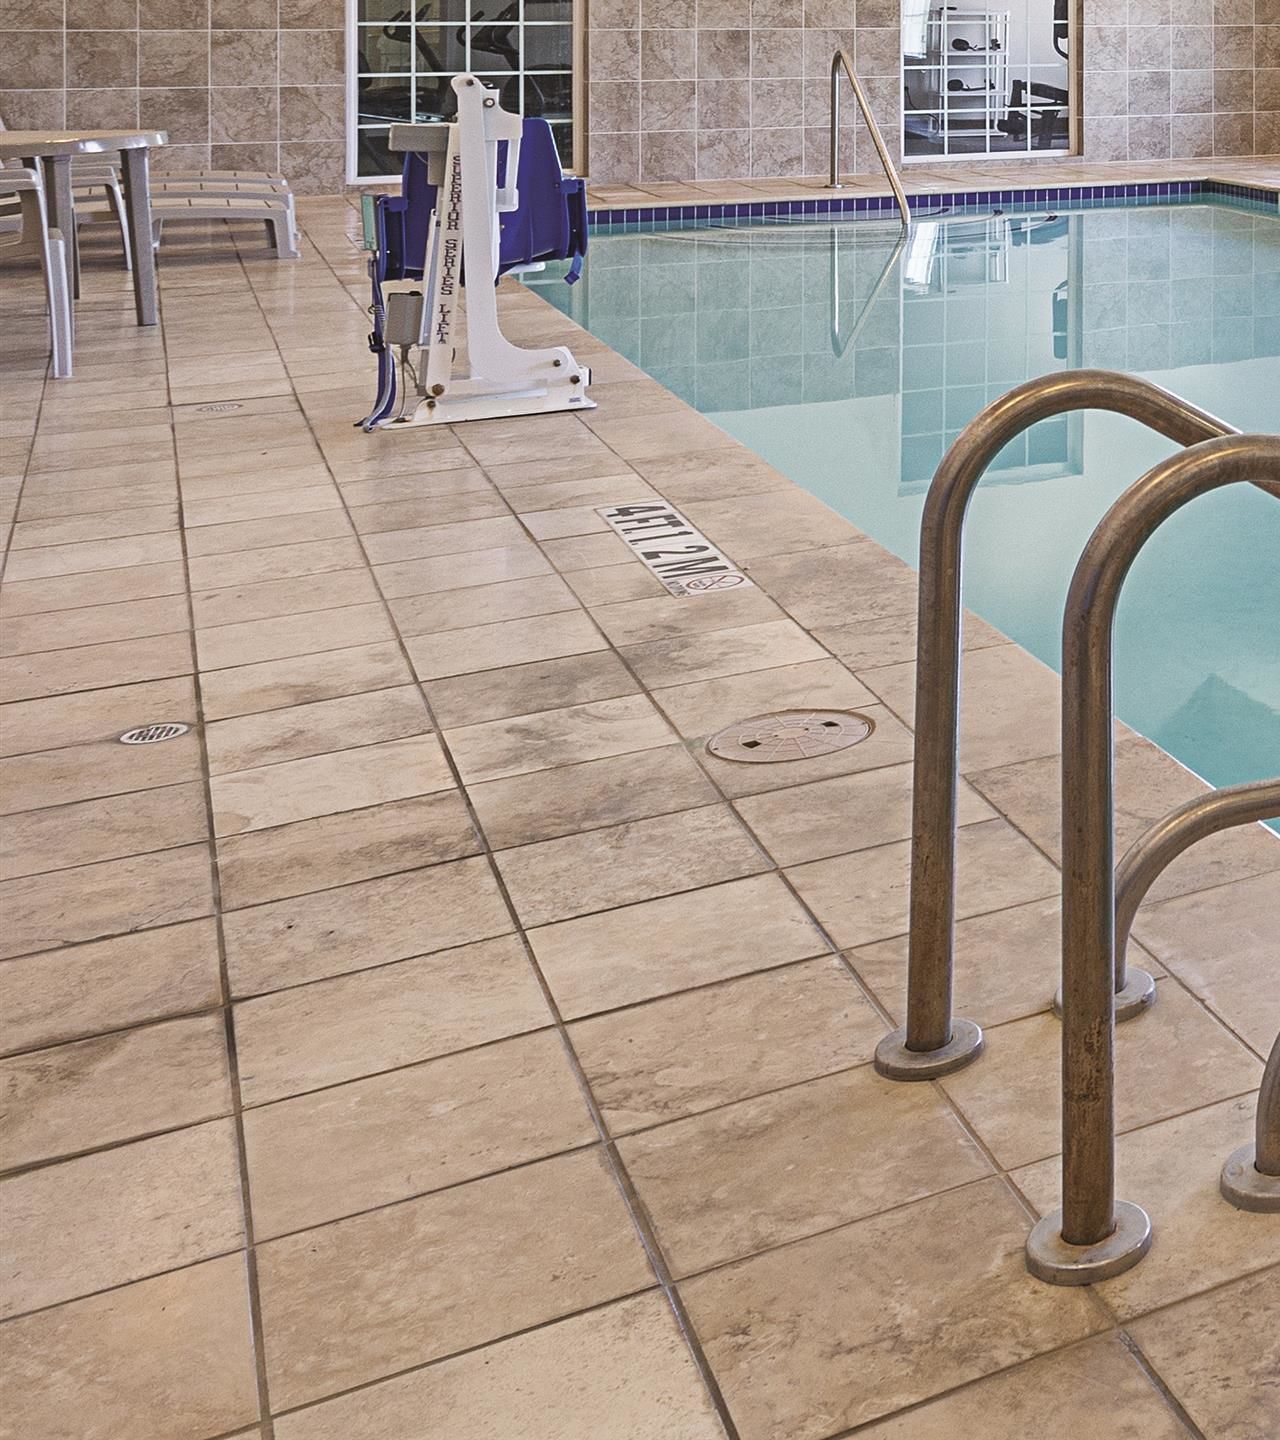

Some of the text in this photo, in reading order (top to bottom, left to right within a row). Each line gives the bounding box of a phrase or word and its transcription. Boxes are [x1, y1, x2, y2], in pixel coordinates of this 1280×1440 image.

[436, 155, 461, 344] SUPERIOR SERIES LIFT
